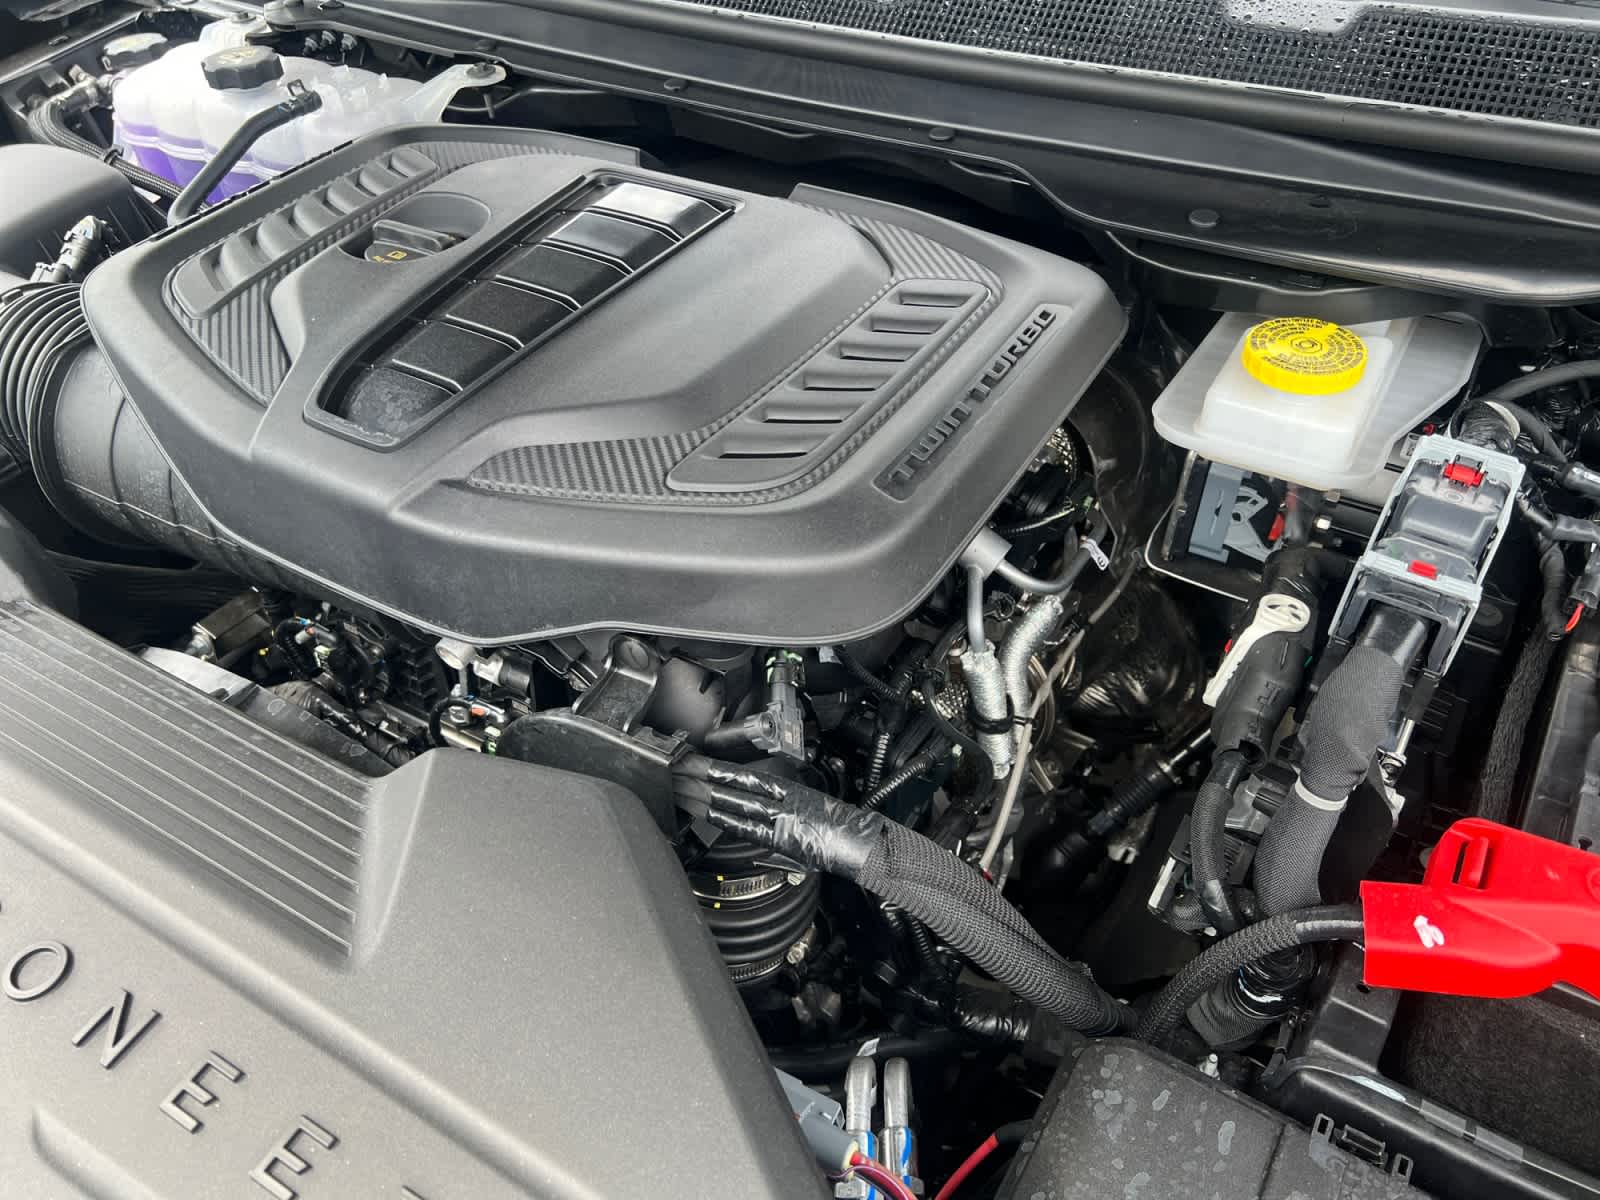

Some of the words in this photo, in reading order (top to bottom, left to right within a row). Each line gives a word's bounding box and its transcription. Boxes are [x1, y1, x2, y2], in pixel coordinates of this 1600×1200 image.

[887, 400, 973, 483] TWIN
[968, 309, 1058, 402] TURBO
[0, 938, 426, 1200] ONEE
